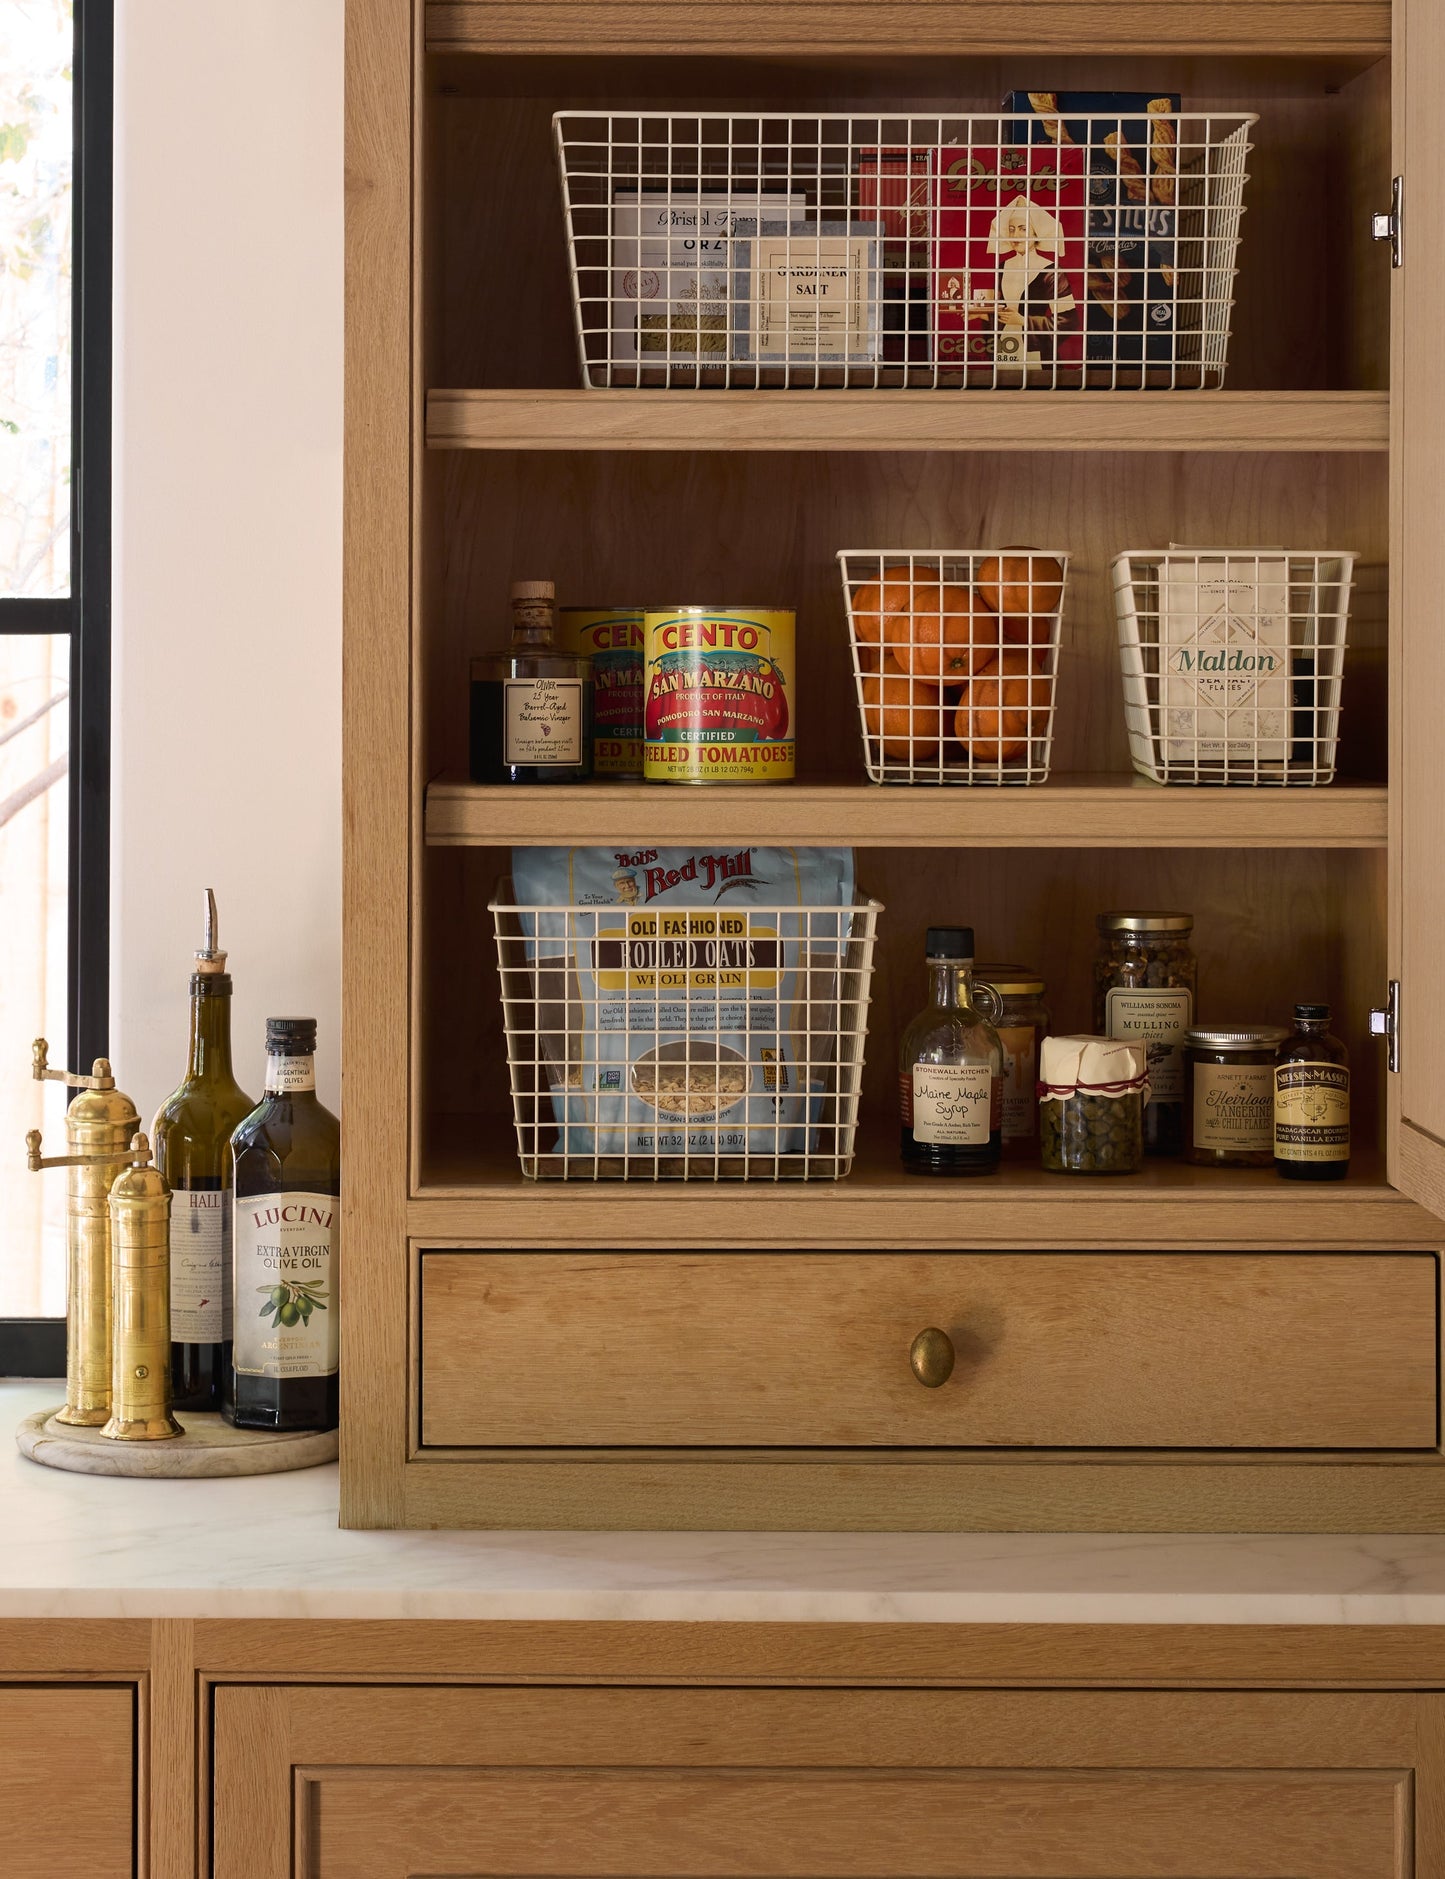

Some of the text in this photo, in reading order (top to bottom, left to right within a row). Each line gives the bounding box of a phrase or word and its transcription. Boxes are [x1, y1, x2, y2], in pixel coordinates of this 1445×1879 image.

[946, 157, 1069, 193] Droste
[657, 211, 709, 226] Bristol
[684, 240, 722, 249] ORZ
[939, 336, 1020, 354] cacao
[997, 354, 1008, 362] 8.8
[593, 624, 644, 649] CEN
[662, 623, 758, 650] CENTO
[1177, 649, 1276, 672] Maldon
[652, 673, 679, 700] SAN
[683, 670, 775, 700] MARZANO
[675, 693, 711, 701] PRODUCT
[725, 693, 746, 701] ITALY
[656, 709, 765, 726] POMODORO SAN MARZANO
[612, 727, 644, 737] CERTI
[680, 731, 736, 741] CERTIFIED
[645, 746, 689, 762] PEELED
[696, 745, 787, 763] TOMATOES
[667, 765, 677, 773] NET
[678, 765, 686, 773] WT
[728, 765, 739, 774] OZ)
[740, 765, 754, 774] 794g
[642, 855, 700, 904] Red
[698, 847, 754, 891] Mill
[631, 919, 744, 936] OLD FASHIONED
[620, 940, 756, 969] ROLLED OATS
[636, 972, 742, 985] WHOLE GRAIN
[1123, 1020, 1180, 1030] MULLING
[1141, 1030, 1165, 1039] spices
[915, 1066, 958, 1075] STONEWALL
[914, 1084, 952, 1099] Maine
[954, 1087, 989, 1105] Maple
[658, 1112, 669, 1120] OU
[935, 1102, 969, 1120] Syrup
[1214, 1105, 1273, 1118] TANGERINE
[1221, 1118, 1243, 1130] CHILI
[1277, 1126, 1322, 1135] MADAGASCAR
[637, 1135, 653, 1147] NET
[657, 1135, 669, 1146] WT
[671, 1135, 682, 1146] 32
[699, 1135, 707, 1147] (2
[1290, 1134, 1325, 1143] VANILLA
[189, 1194, 221, 1208] HALL
[252, 1204, 334, 1230] LUCINI
[256, 1244, 331, 1258] EXTRA VIRGIN
[263, 1257, 323, 1269] OLIVE OIL
